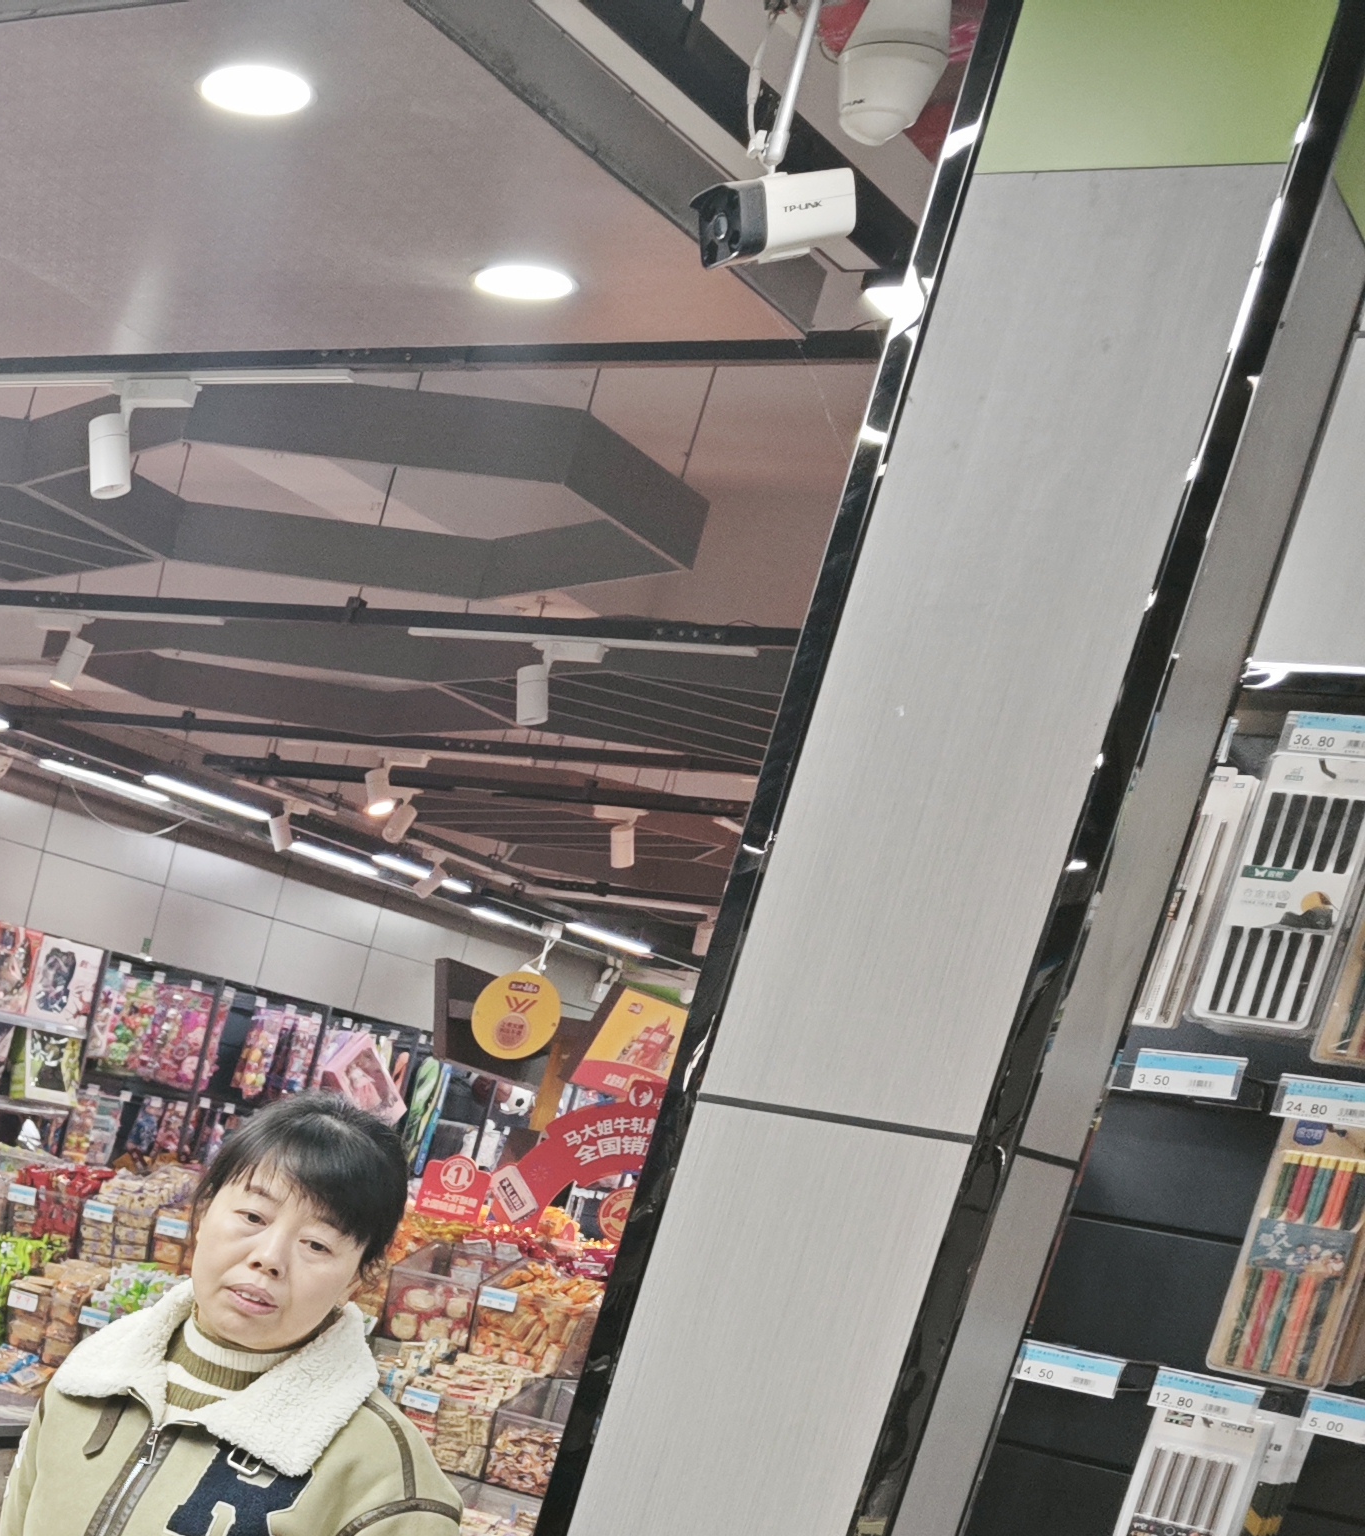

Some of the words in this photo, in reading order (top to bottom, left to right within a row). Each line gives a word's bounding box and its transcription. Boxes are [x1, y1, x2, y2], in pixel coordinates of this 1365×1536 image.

[783, 200, 823, 213] TP-LINK
[1293, 734, 1336, 749] 36.80
[1138, 1073, 1170, 1087] 3.50
[1285, 1101, 1328, 1115] 24.80
[1023, 1365, 1054, 1380] 4.50
[1154, 1391, 1194, 1409] 12.80
[1309, 1416, 1344, 1433] 5.00
